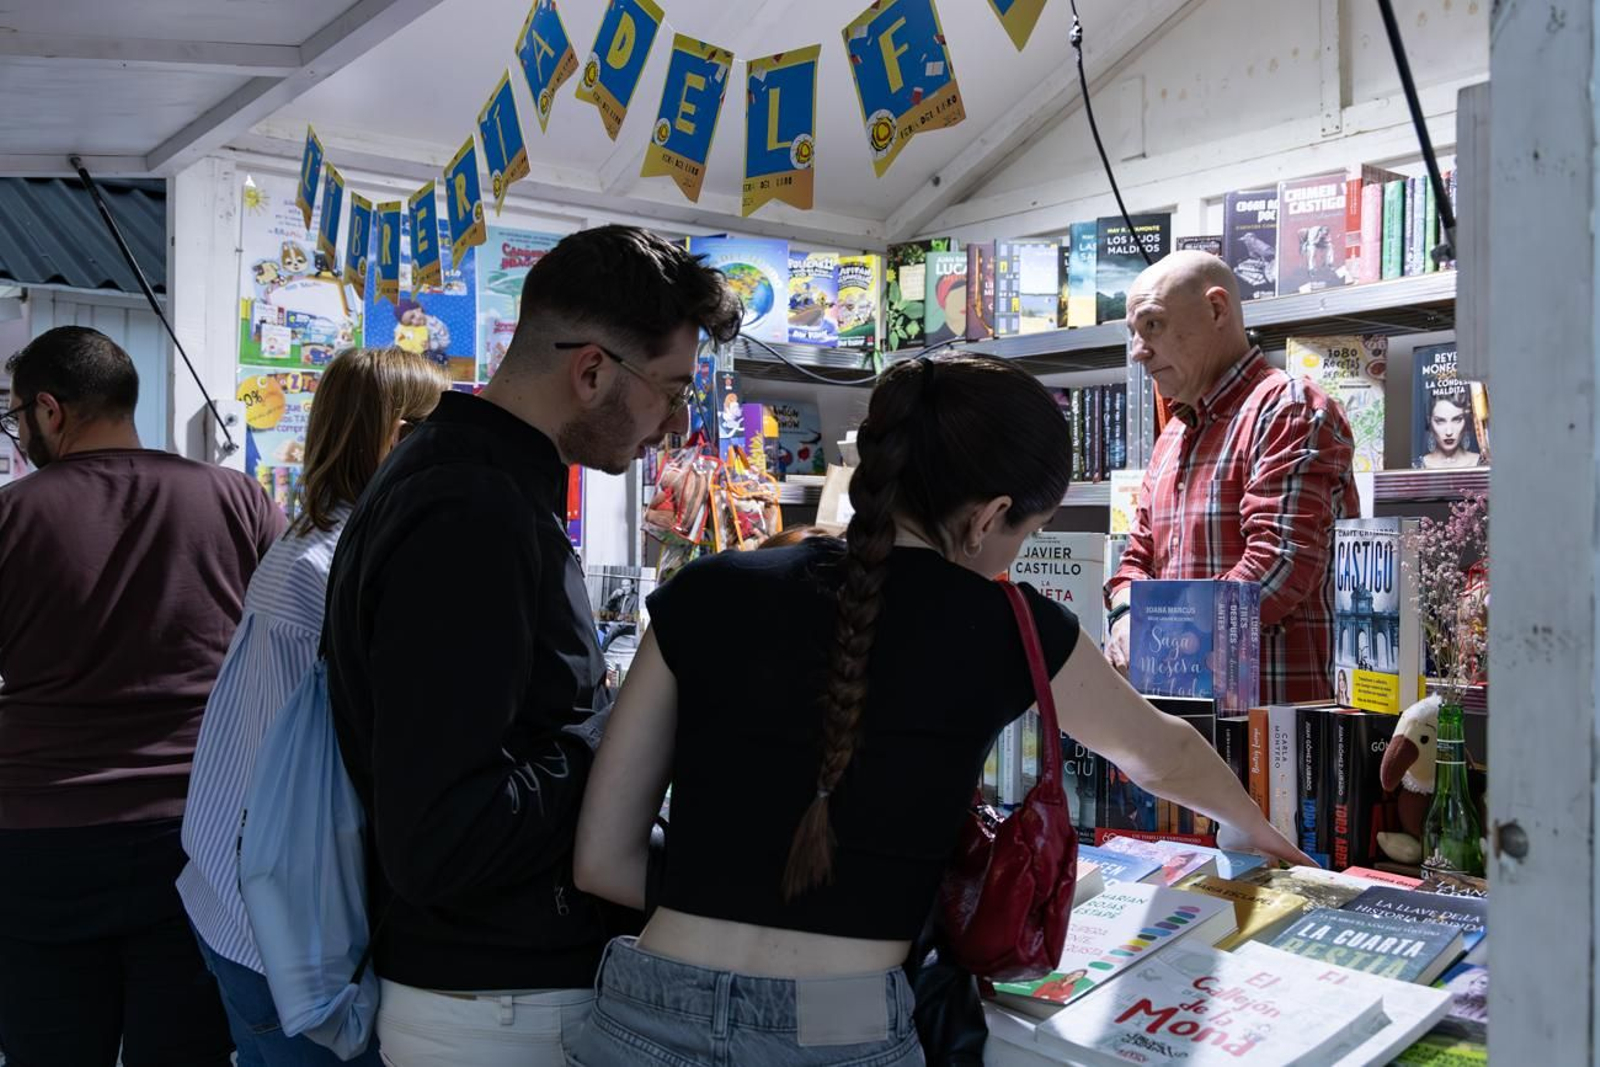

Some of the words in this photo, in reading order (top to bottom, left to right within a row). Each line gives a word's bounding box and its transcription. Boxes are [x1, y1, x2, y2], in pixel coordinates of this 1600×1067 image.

[1107, 236, 1127, 246] LOS
[935, 263, 967, 275] LUCA
[1327, 348, 1358, 359] 1080
[1434, 351, 1458, 364] REYE
[1425, 381, 1435, 389] LA
[1432, 386, 1466, 396] MALDITA
[1024, 547, 1072, 559] JAVIER
[1015, 562, 1082, 576] CASTILLO
[1337, 540, 1394, 594] CASTIGO
[1040, 589, 1074, 602] IETA
[1149, 624, 1190, 660] Saga
[1281, 733, 1289, 763] CARLA
[1302, 798, 1316, 827] TODO
[1335, 803, 1348, 834] TODO
[1335, 837, 1348, 868] ARDE
[1098, 893, 1147, 905] MARIAN
[1355, 904, 1418, 923] HISTORIA
[1375, 899, 1394, 909] LA
[1395, 902, 1439, 917] LLAVE
[1440, 910, 1461, 921] DE
[1460, 913, 1482, 923] LA
[1297, 921, 1332, 941] LA
[1333, 928, 1427, 959] CUARTA
[1280, 936, 1410, 980] BESTIA
[1245, 971, 1282, 989] El
[1178, 998, 1210, 1015] de
[1207, 1010, 1235, 1028] la
[1113, 997, 1259, 1058] Mona
